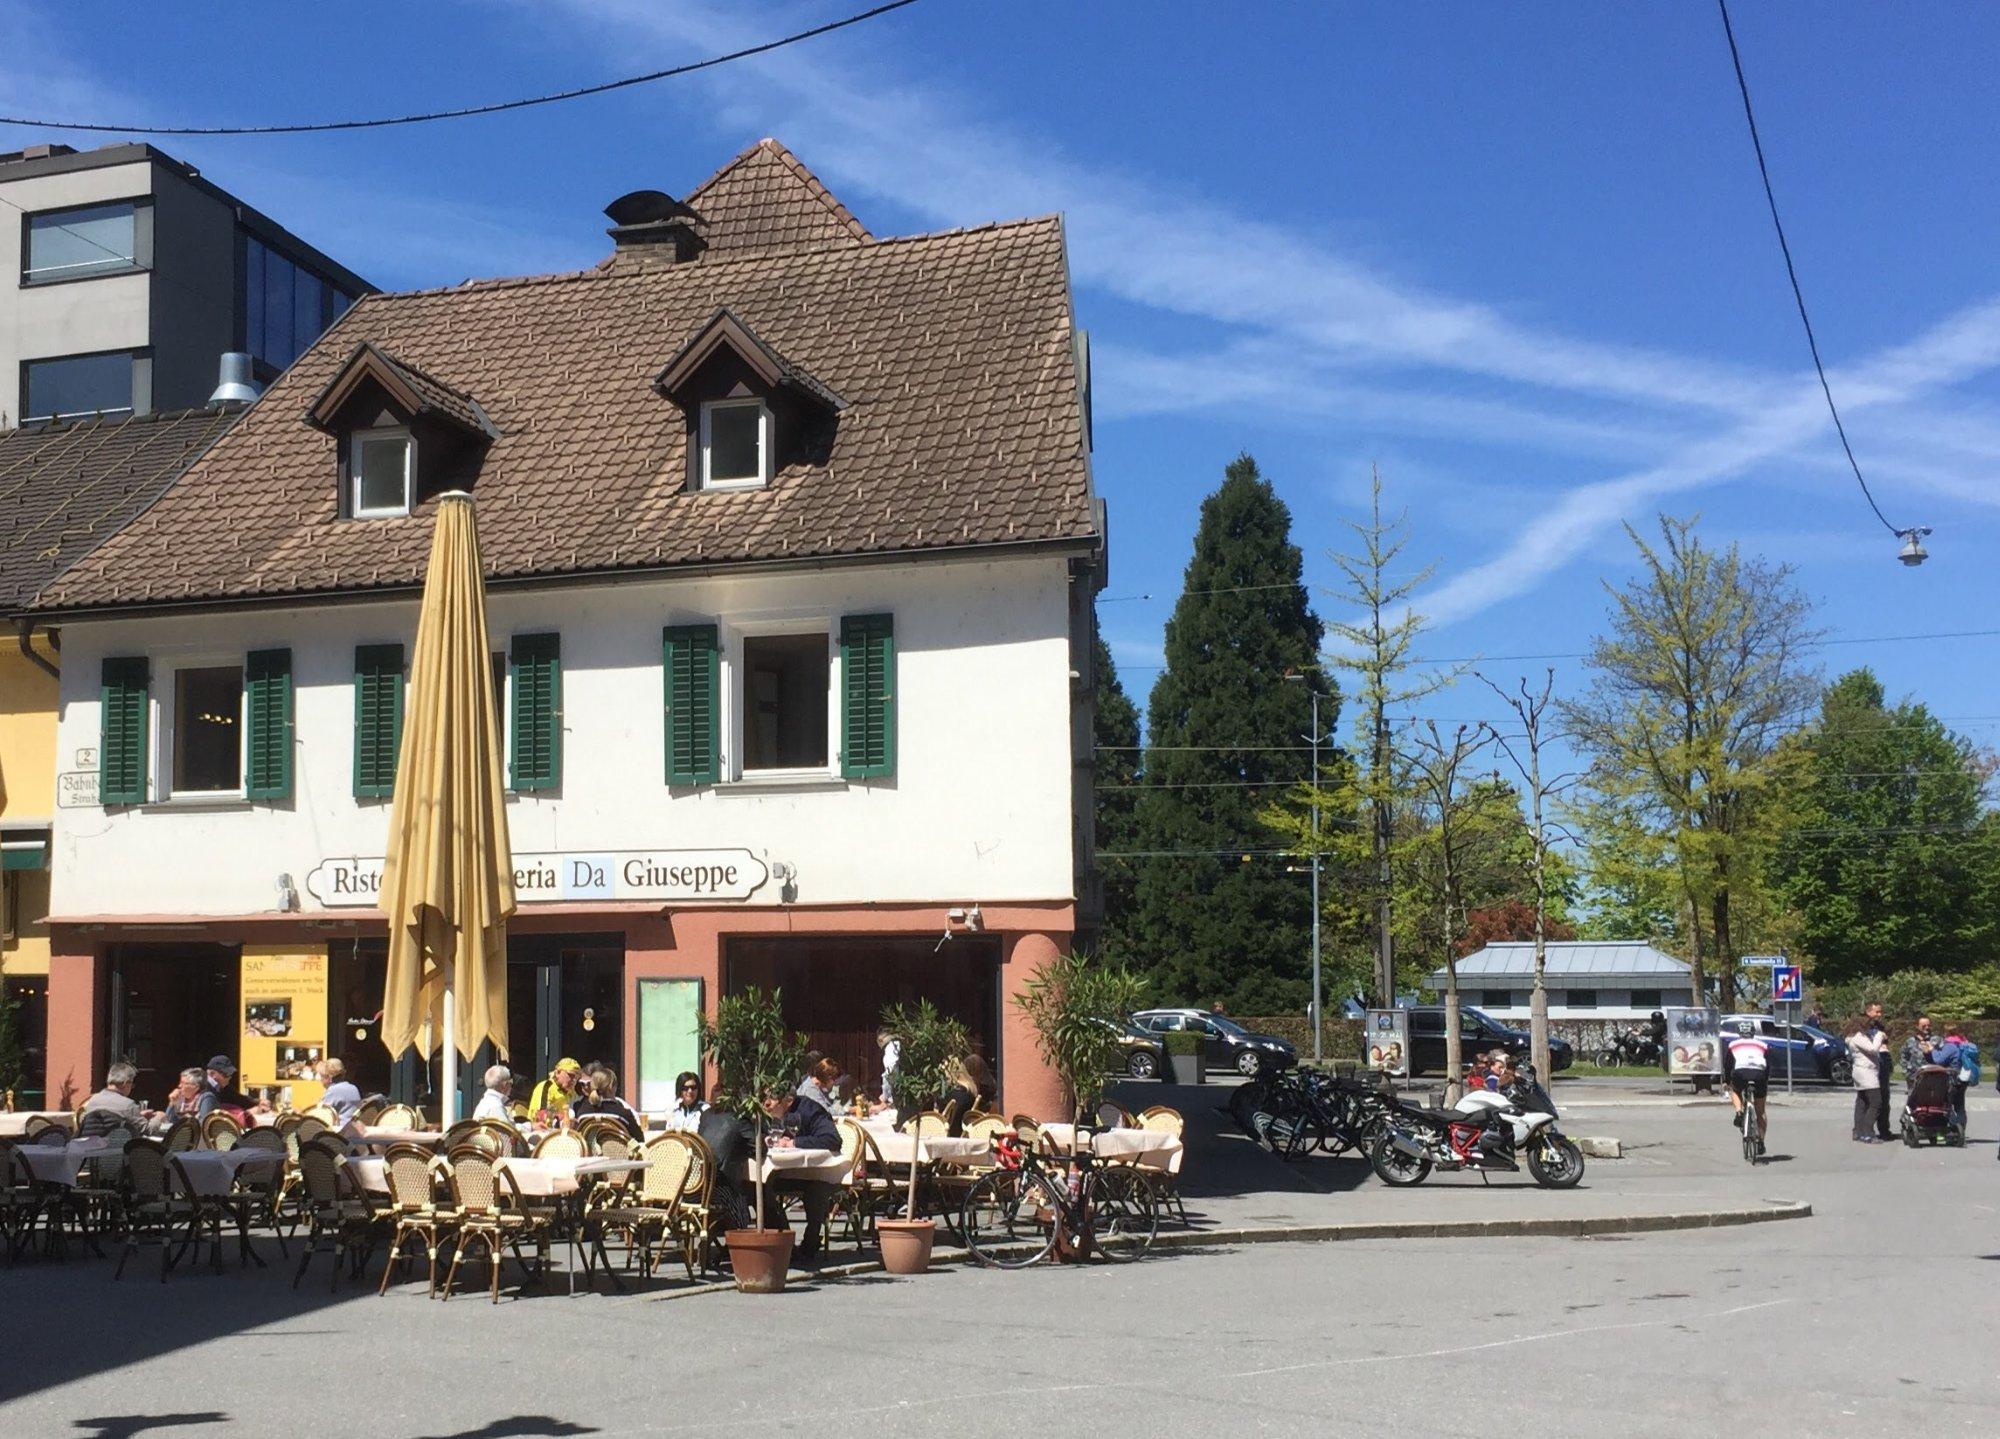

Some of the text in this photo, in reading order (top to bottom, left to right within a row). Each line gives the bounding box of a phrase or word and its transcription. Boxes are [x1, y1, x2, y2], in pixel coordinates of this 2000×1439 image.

[83, 750, 91, 762] 2
[513, 861, 556, 889] eria
[572, 861, 606, 888] Da
[623, 858, 738, 893] Giuseppe
